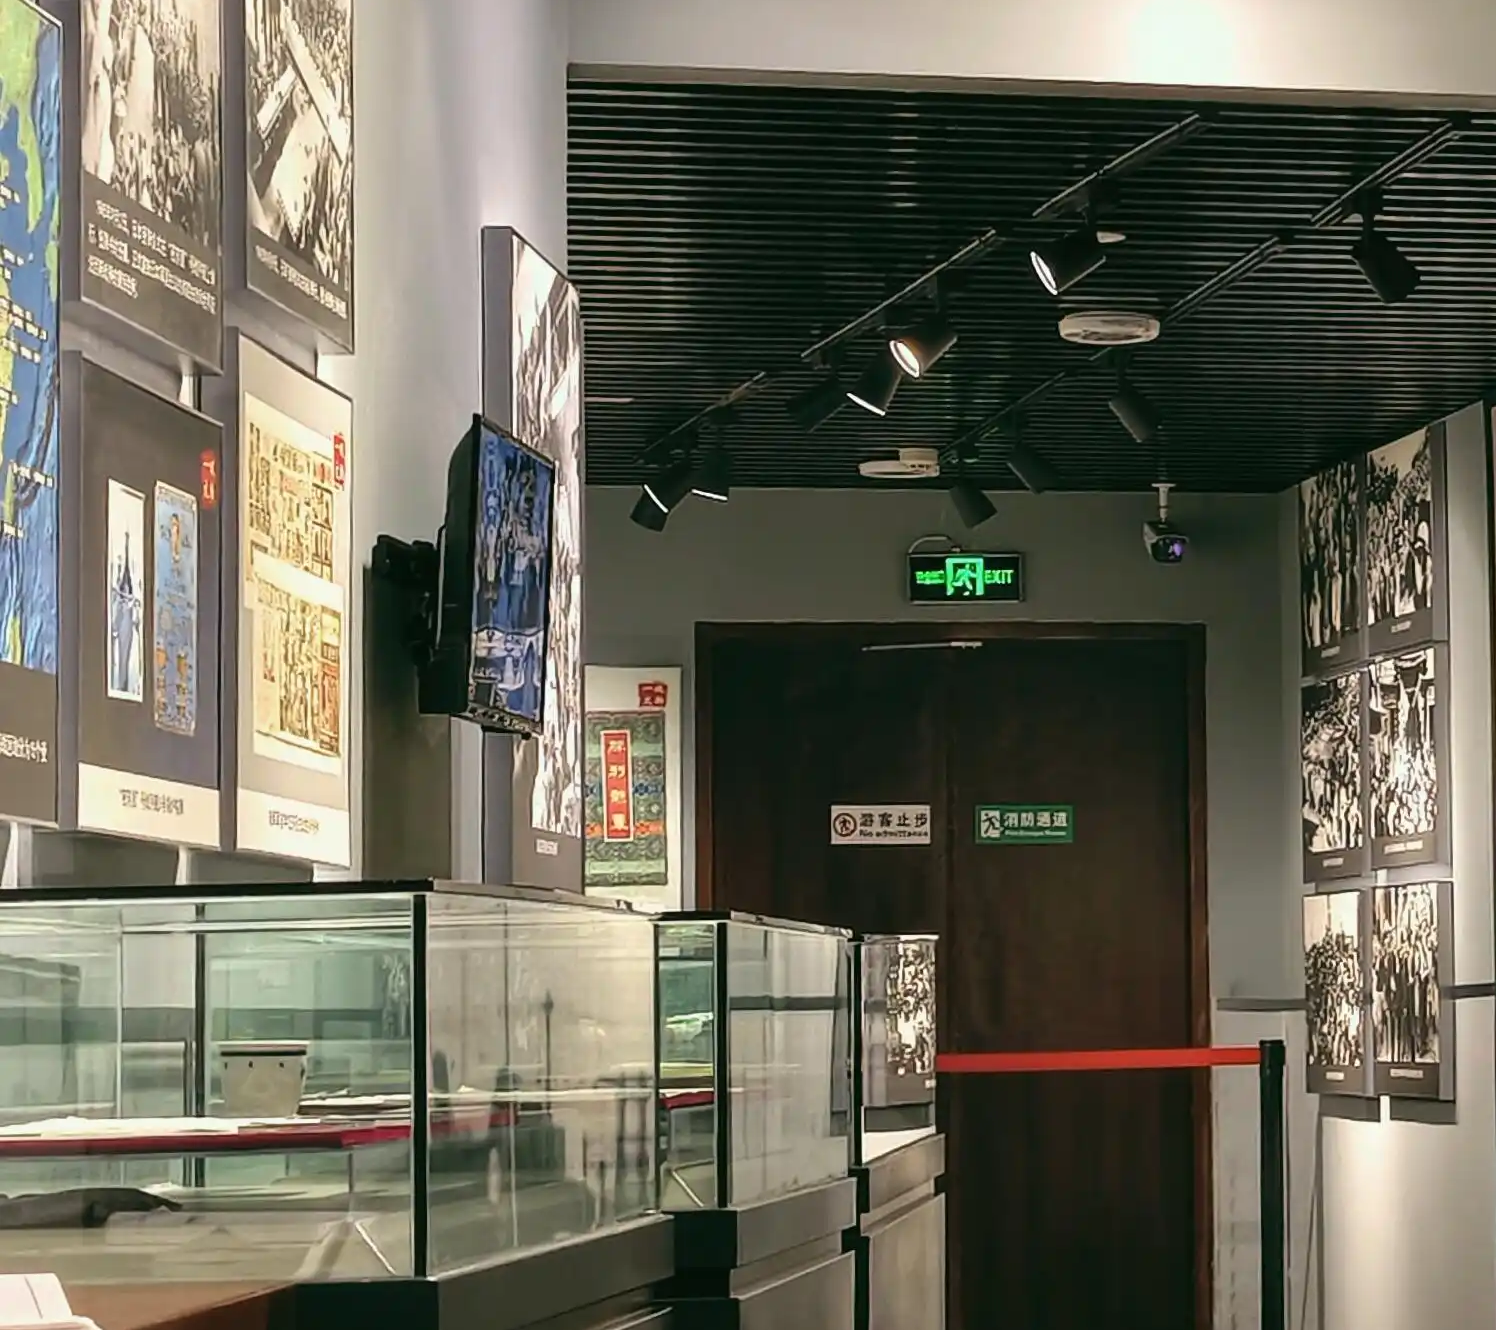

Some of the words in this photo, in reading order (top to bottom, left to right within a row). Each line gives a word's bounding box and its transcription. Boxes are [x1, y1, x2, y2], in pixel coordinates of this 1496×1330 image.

[984, 569, 1014, 584] EXIT
[859, 812, 928, 828] 游客止步
[1003, 811, 1068, 828] 消防通道
